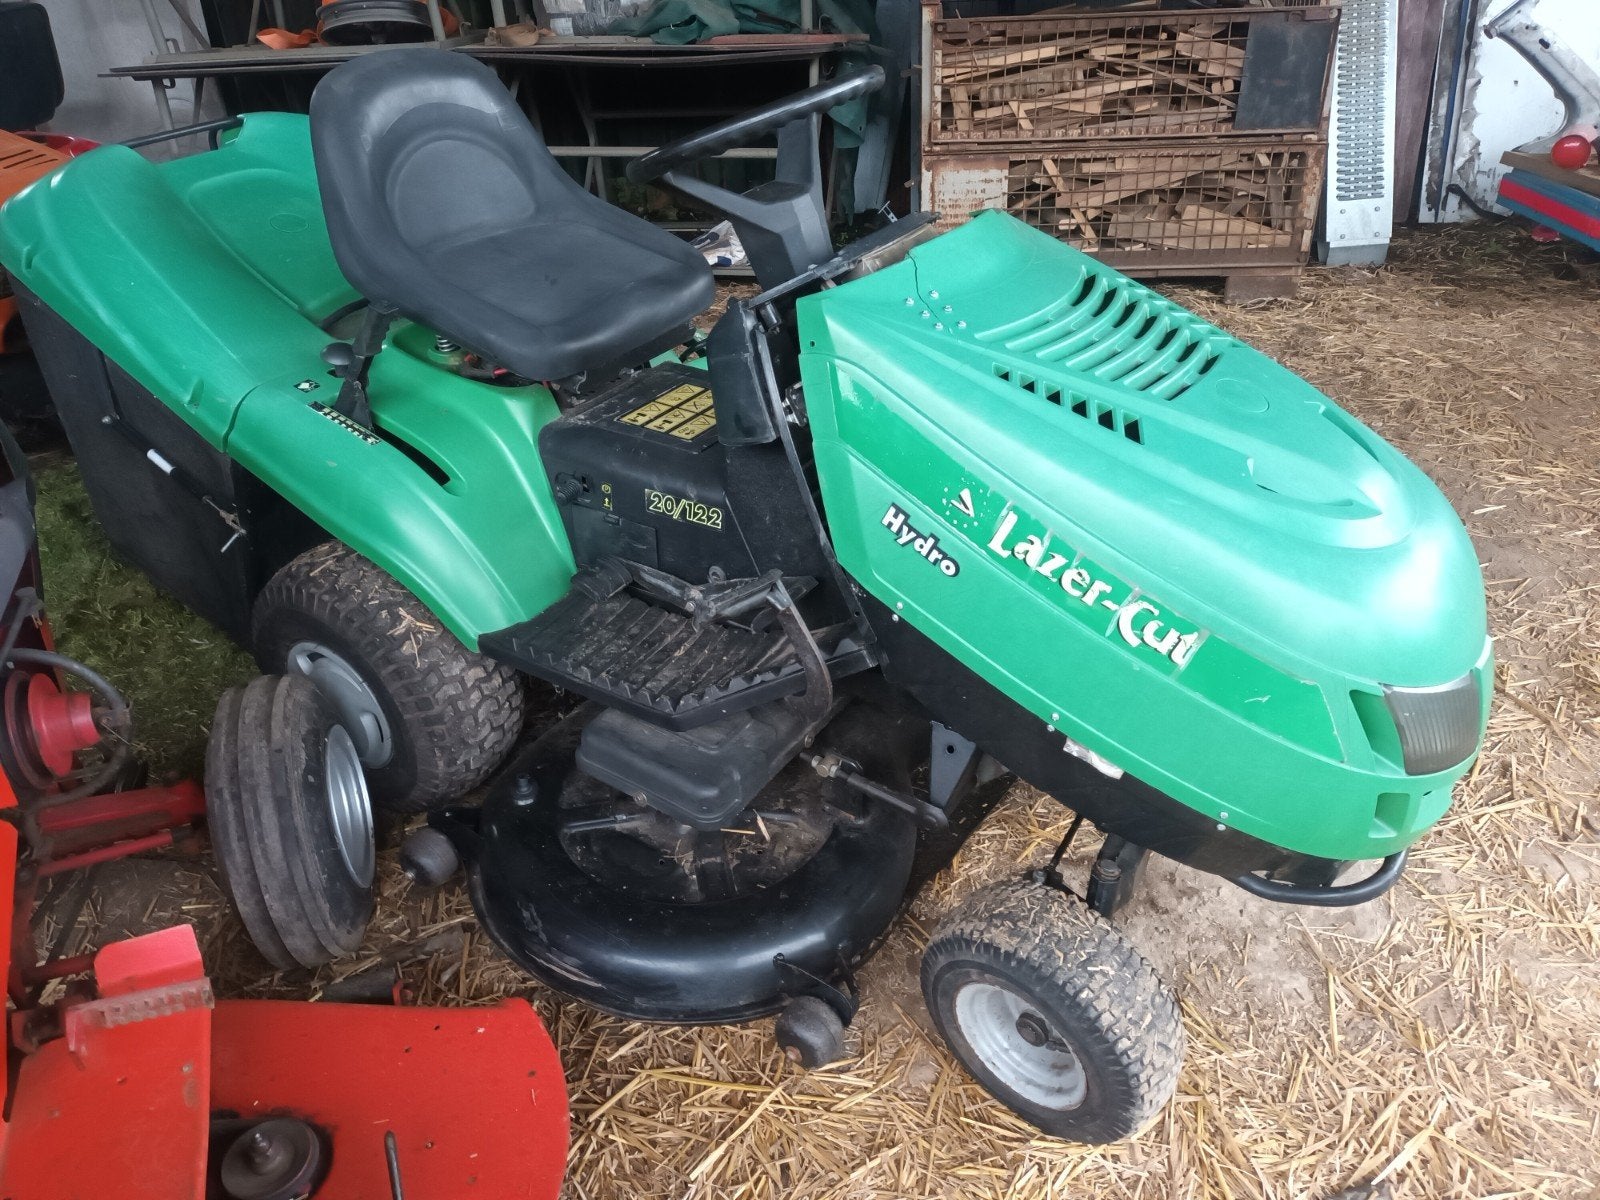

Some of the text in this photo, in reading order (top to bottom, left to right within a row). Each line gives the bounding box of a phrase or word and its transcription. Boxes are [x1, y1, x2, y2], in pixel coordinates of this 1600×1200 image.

[649, 491, 723, 529] 20/122
[880, 503, 960, 577] Hydro
[987, 510, 1199, 666] Lazer-Cut
